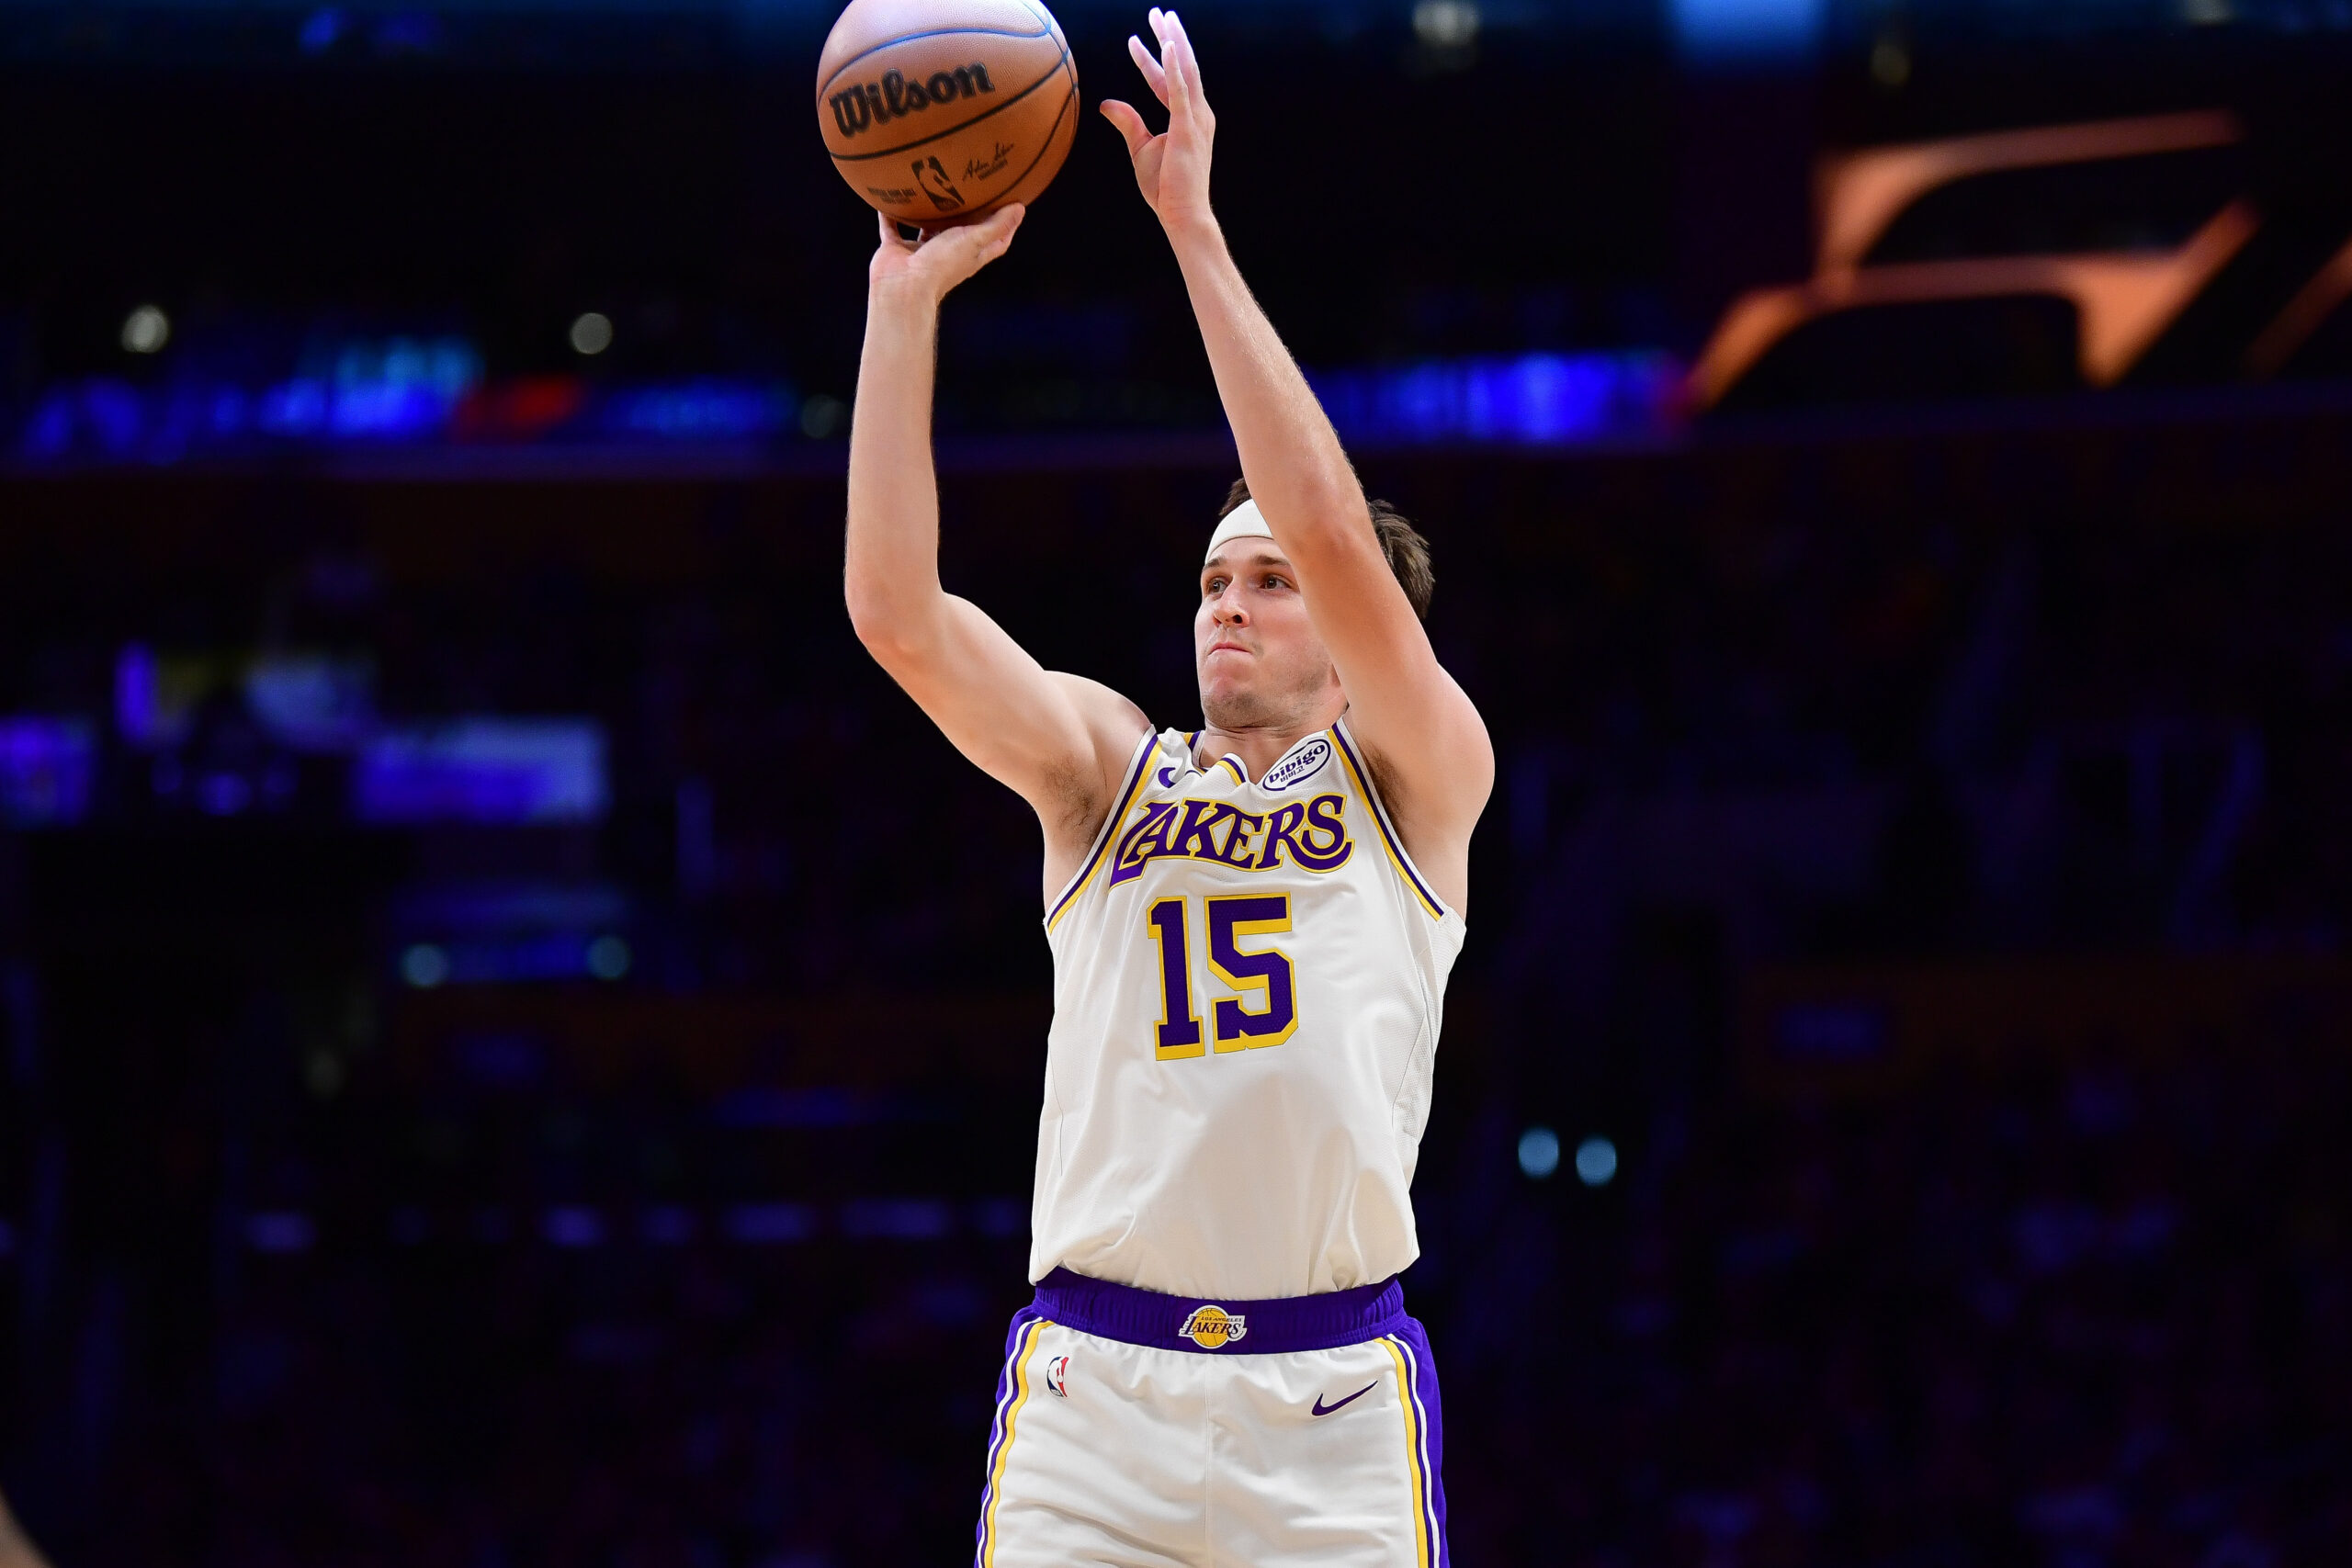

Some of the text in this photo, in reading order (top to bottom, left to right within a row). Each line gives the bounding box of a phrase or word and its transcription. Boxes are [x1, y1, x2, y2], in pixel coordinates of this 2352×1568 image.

[829, 61, 994, 137] Wilson
[1268, 744, 1325, 784] bibigo
[1280, 765, 1305, 782] 비비고
[1109, 793, 1355, 889] LAKERS
[1147, 891, 1298, 1061] 15
[1180, 1315, 1245, 1339] LAKERS
